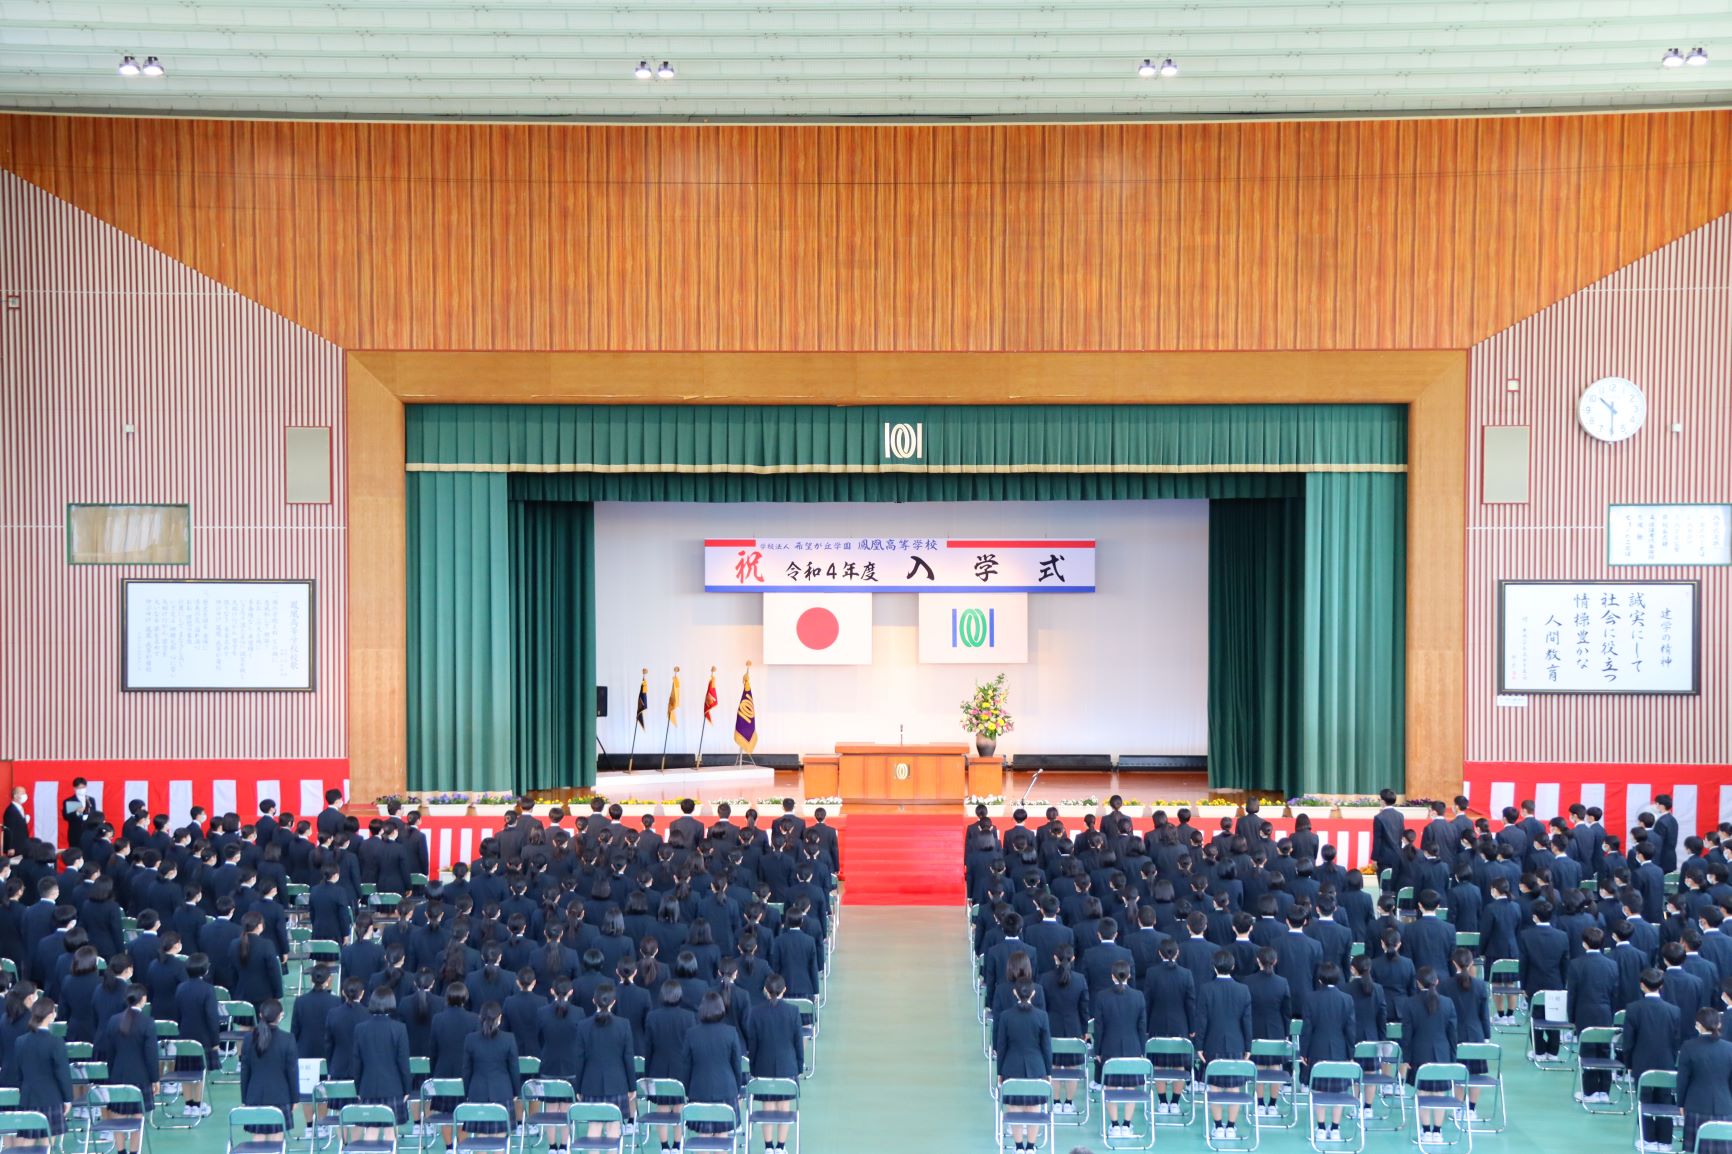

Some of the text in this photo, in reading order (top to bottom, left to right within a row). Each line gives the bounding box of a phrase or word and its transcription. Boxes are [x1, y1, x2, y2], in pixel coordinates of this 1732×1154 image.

[735, 550, 765, 584] 祝
[785, 560, 879, 582] 令和4年度
[858, 538, 938, 551] 鳳凰高等学校
[1544, 614, 1563, 683] 人間教育
[1600, 592, 1621, 683] 社会に役立つ
[1629, 592, 1646, 673] 誠実にして
